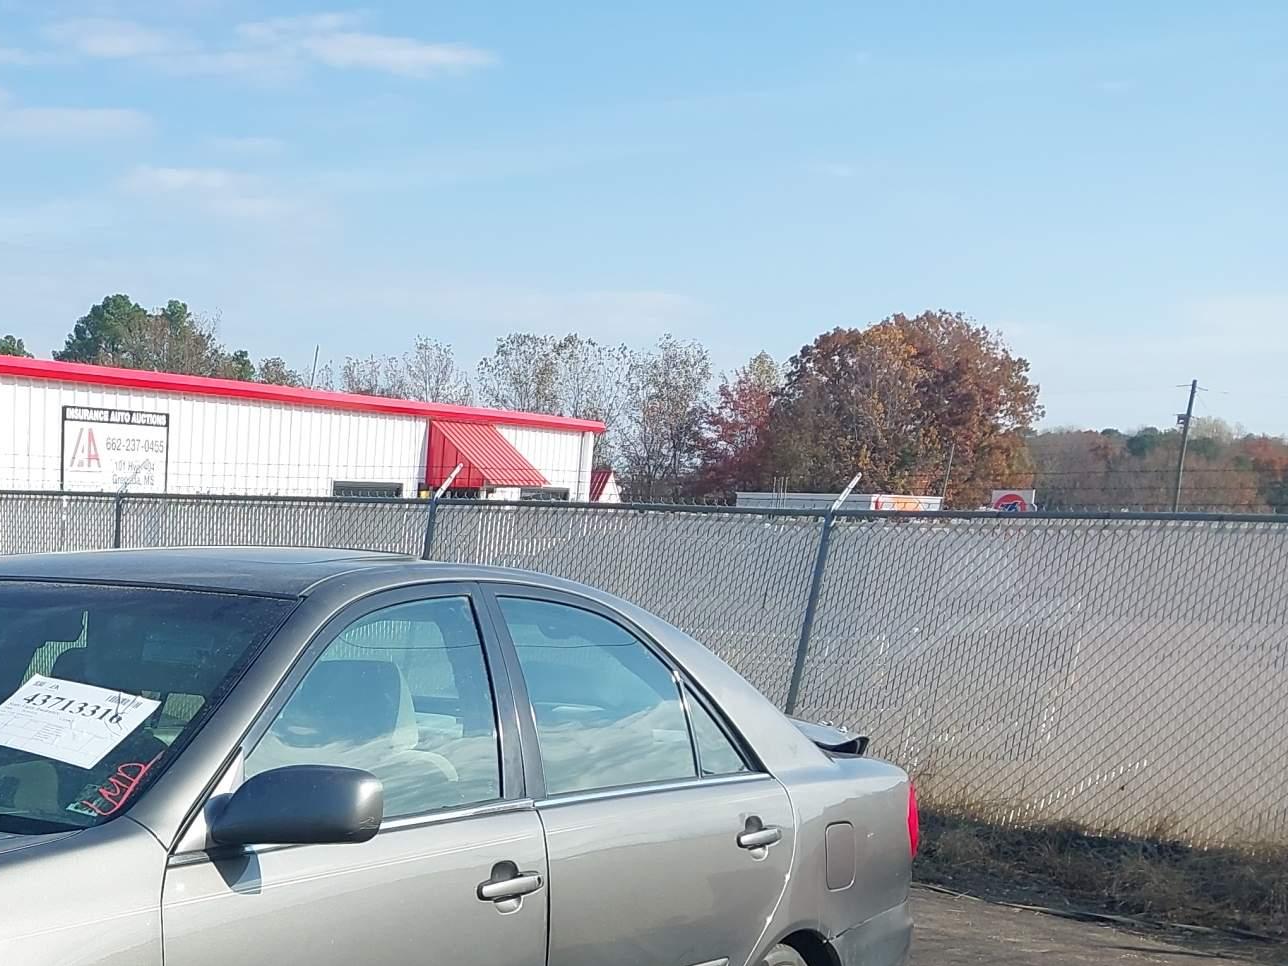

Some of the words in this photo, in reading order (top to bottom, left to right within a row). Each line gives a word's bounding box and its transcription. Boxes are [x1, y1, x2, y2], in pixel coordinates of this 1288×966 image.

[66, 407, 109, 422] INSURANCE
[110, 410, 131, 424] AUTO
[131, 412, 167, 426] AUCTIONS
[106, 437, 164, 453] 662-237-0455
[23, 692, 123, 725] 43713316
